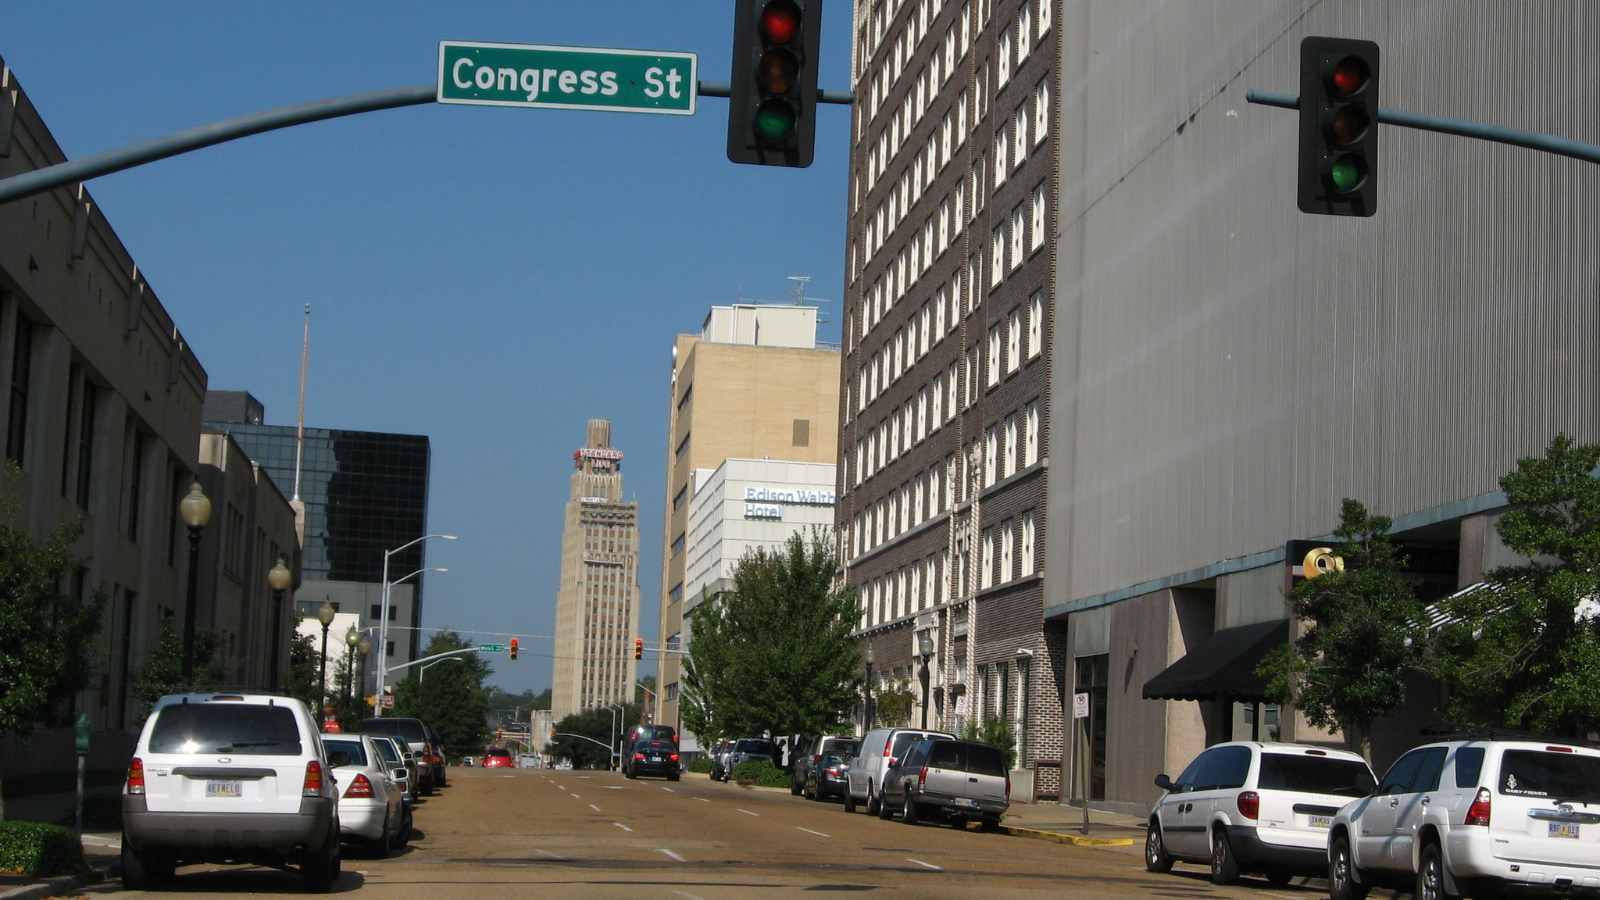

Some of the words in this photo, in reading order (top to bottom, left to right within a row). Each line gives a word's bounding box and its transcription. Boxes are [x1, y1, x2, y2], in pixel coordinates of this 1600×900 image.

[452, 57, 619, 101] Congress
[643, 66, 682, 99] St
[746, 487, 794, 502] Edison
[745, 503, 782, 518] Hotel
